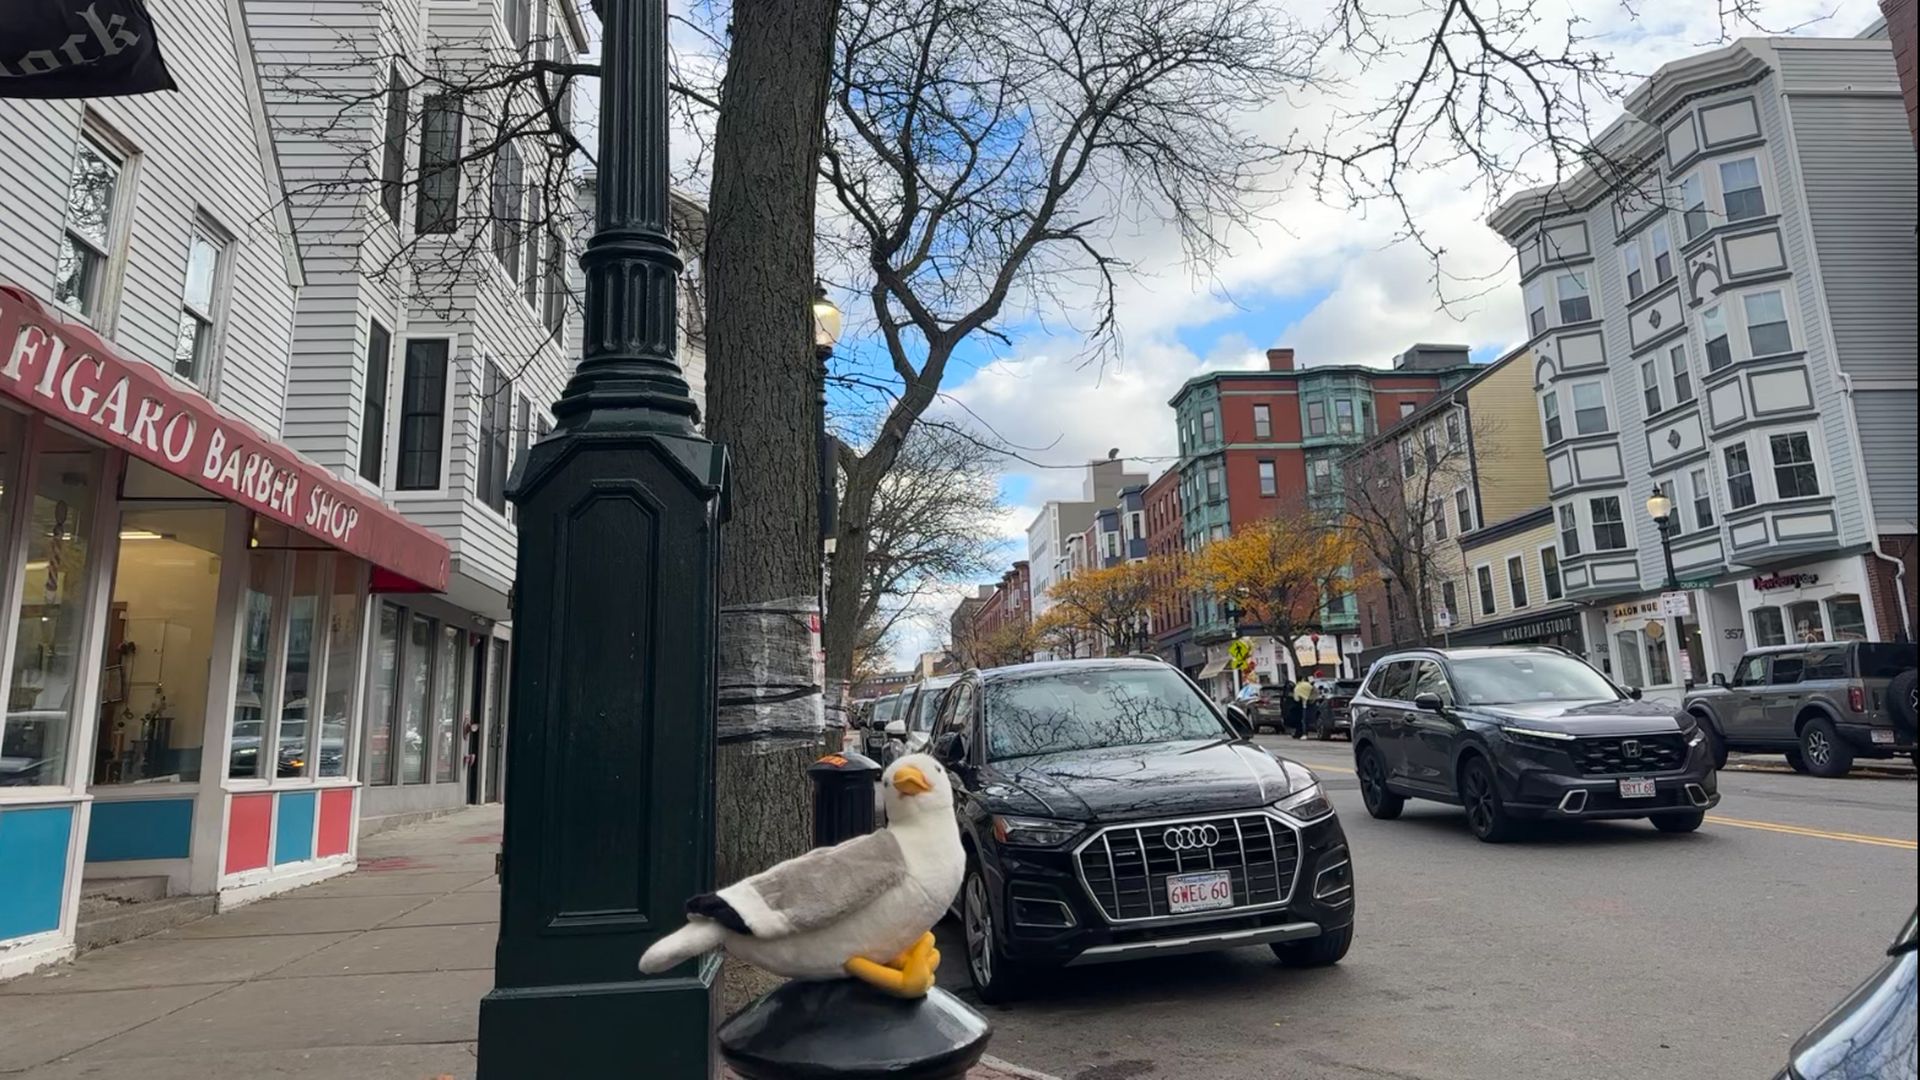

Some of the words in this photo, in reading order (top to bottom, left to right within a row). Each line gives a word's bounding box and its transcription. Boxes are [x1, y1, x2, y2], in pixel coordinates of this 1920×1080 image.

[0, 2, 141, 77] ock
[1, 324, 197, 463] FIGARO
[203, 427, 299, 517] BARBER
[305, 484, 359, 543] SHOP
[1613, 605, 1638, 619] SALON
[1641, 602, 1658, 614] HUE
[1503, 626, 1522, 641] MICRO
[1523, 622, 1545, 639] PLANT
[1545, 617, 1572, 634] STUDIO
[1724, 628, 1744, 640] 357
[1171, 883, 1208, 904] 6WEC
[1211, 880, 1229, 900] 60
